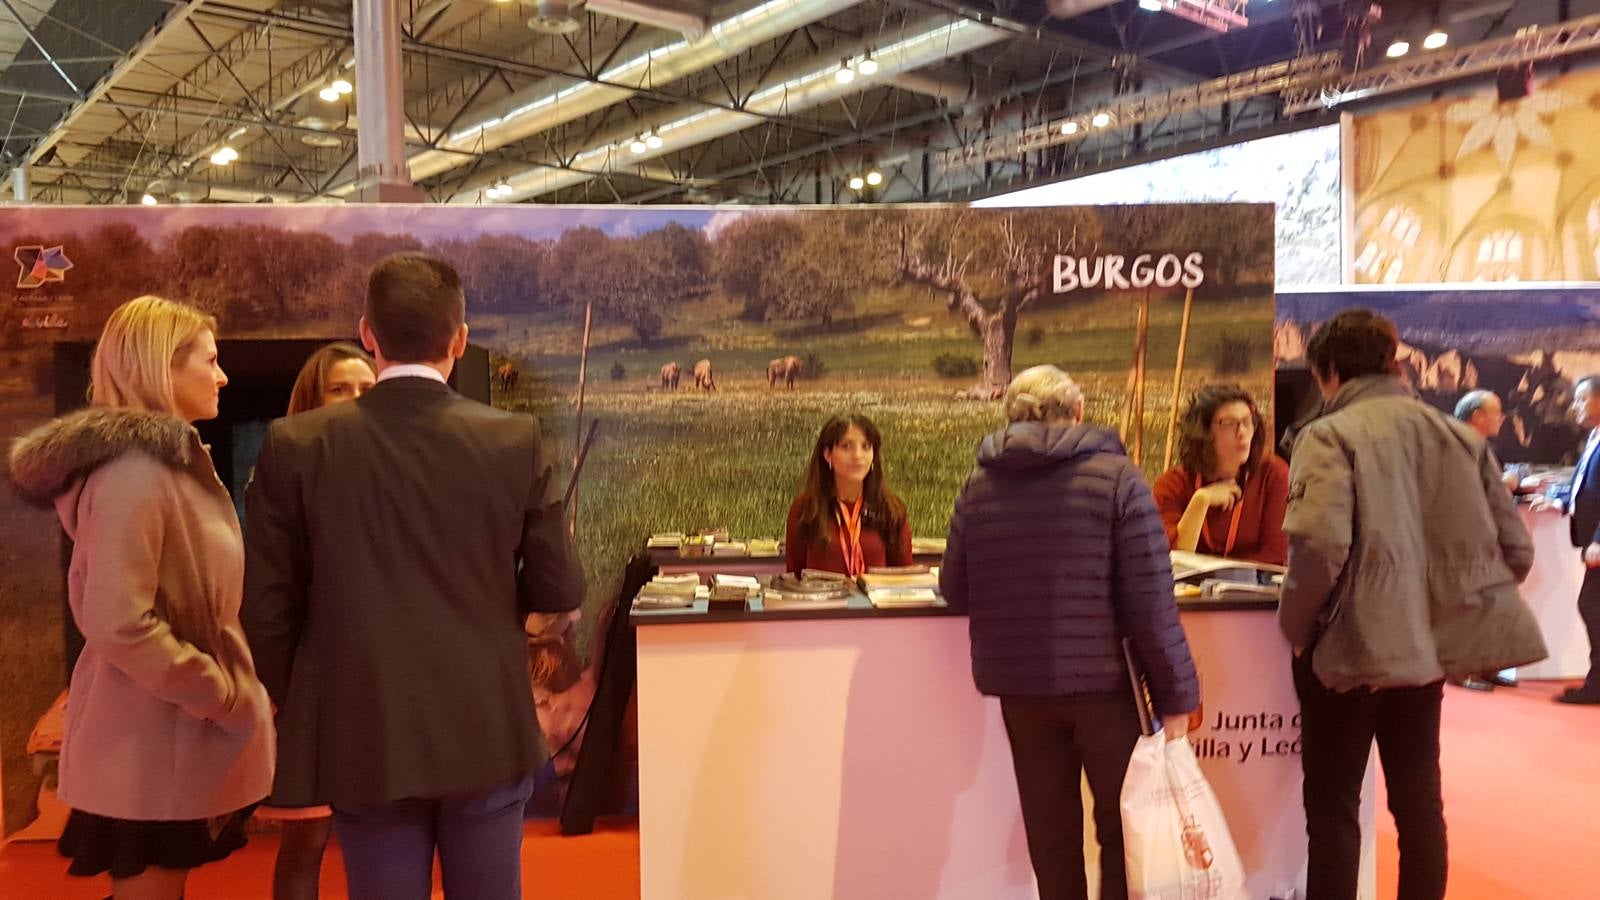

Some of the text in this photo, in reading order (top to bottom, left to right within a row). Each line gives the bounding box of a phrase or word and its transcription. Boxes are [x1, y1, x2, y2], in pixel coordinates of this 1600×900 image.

[1053, 252, 1204, 294] BURGOS
[1211, 711, 1283, 730] Junta
[1193, 736, 1302, 763] illa y Leó
